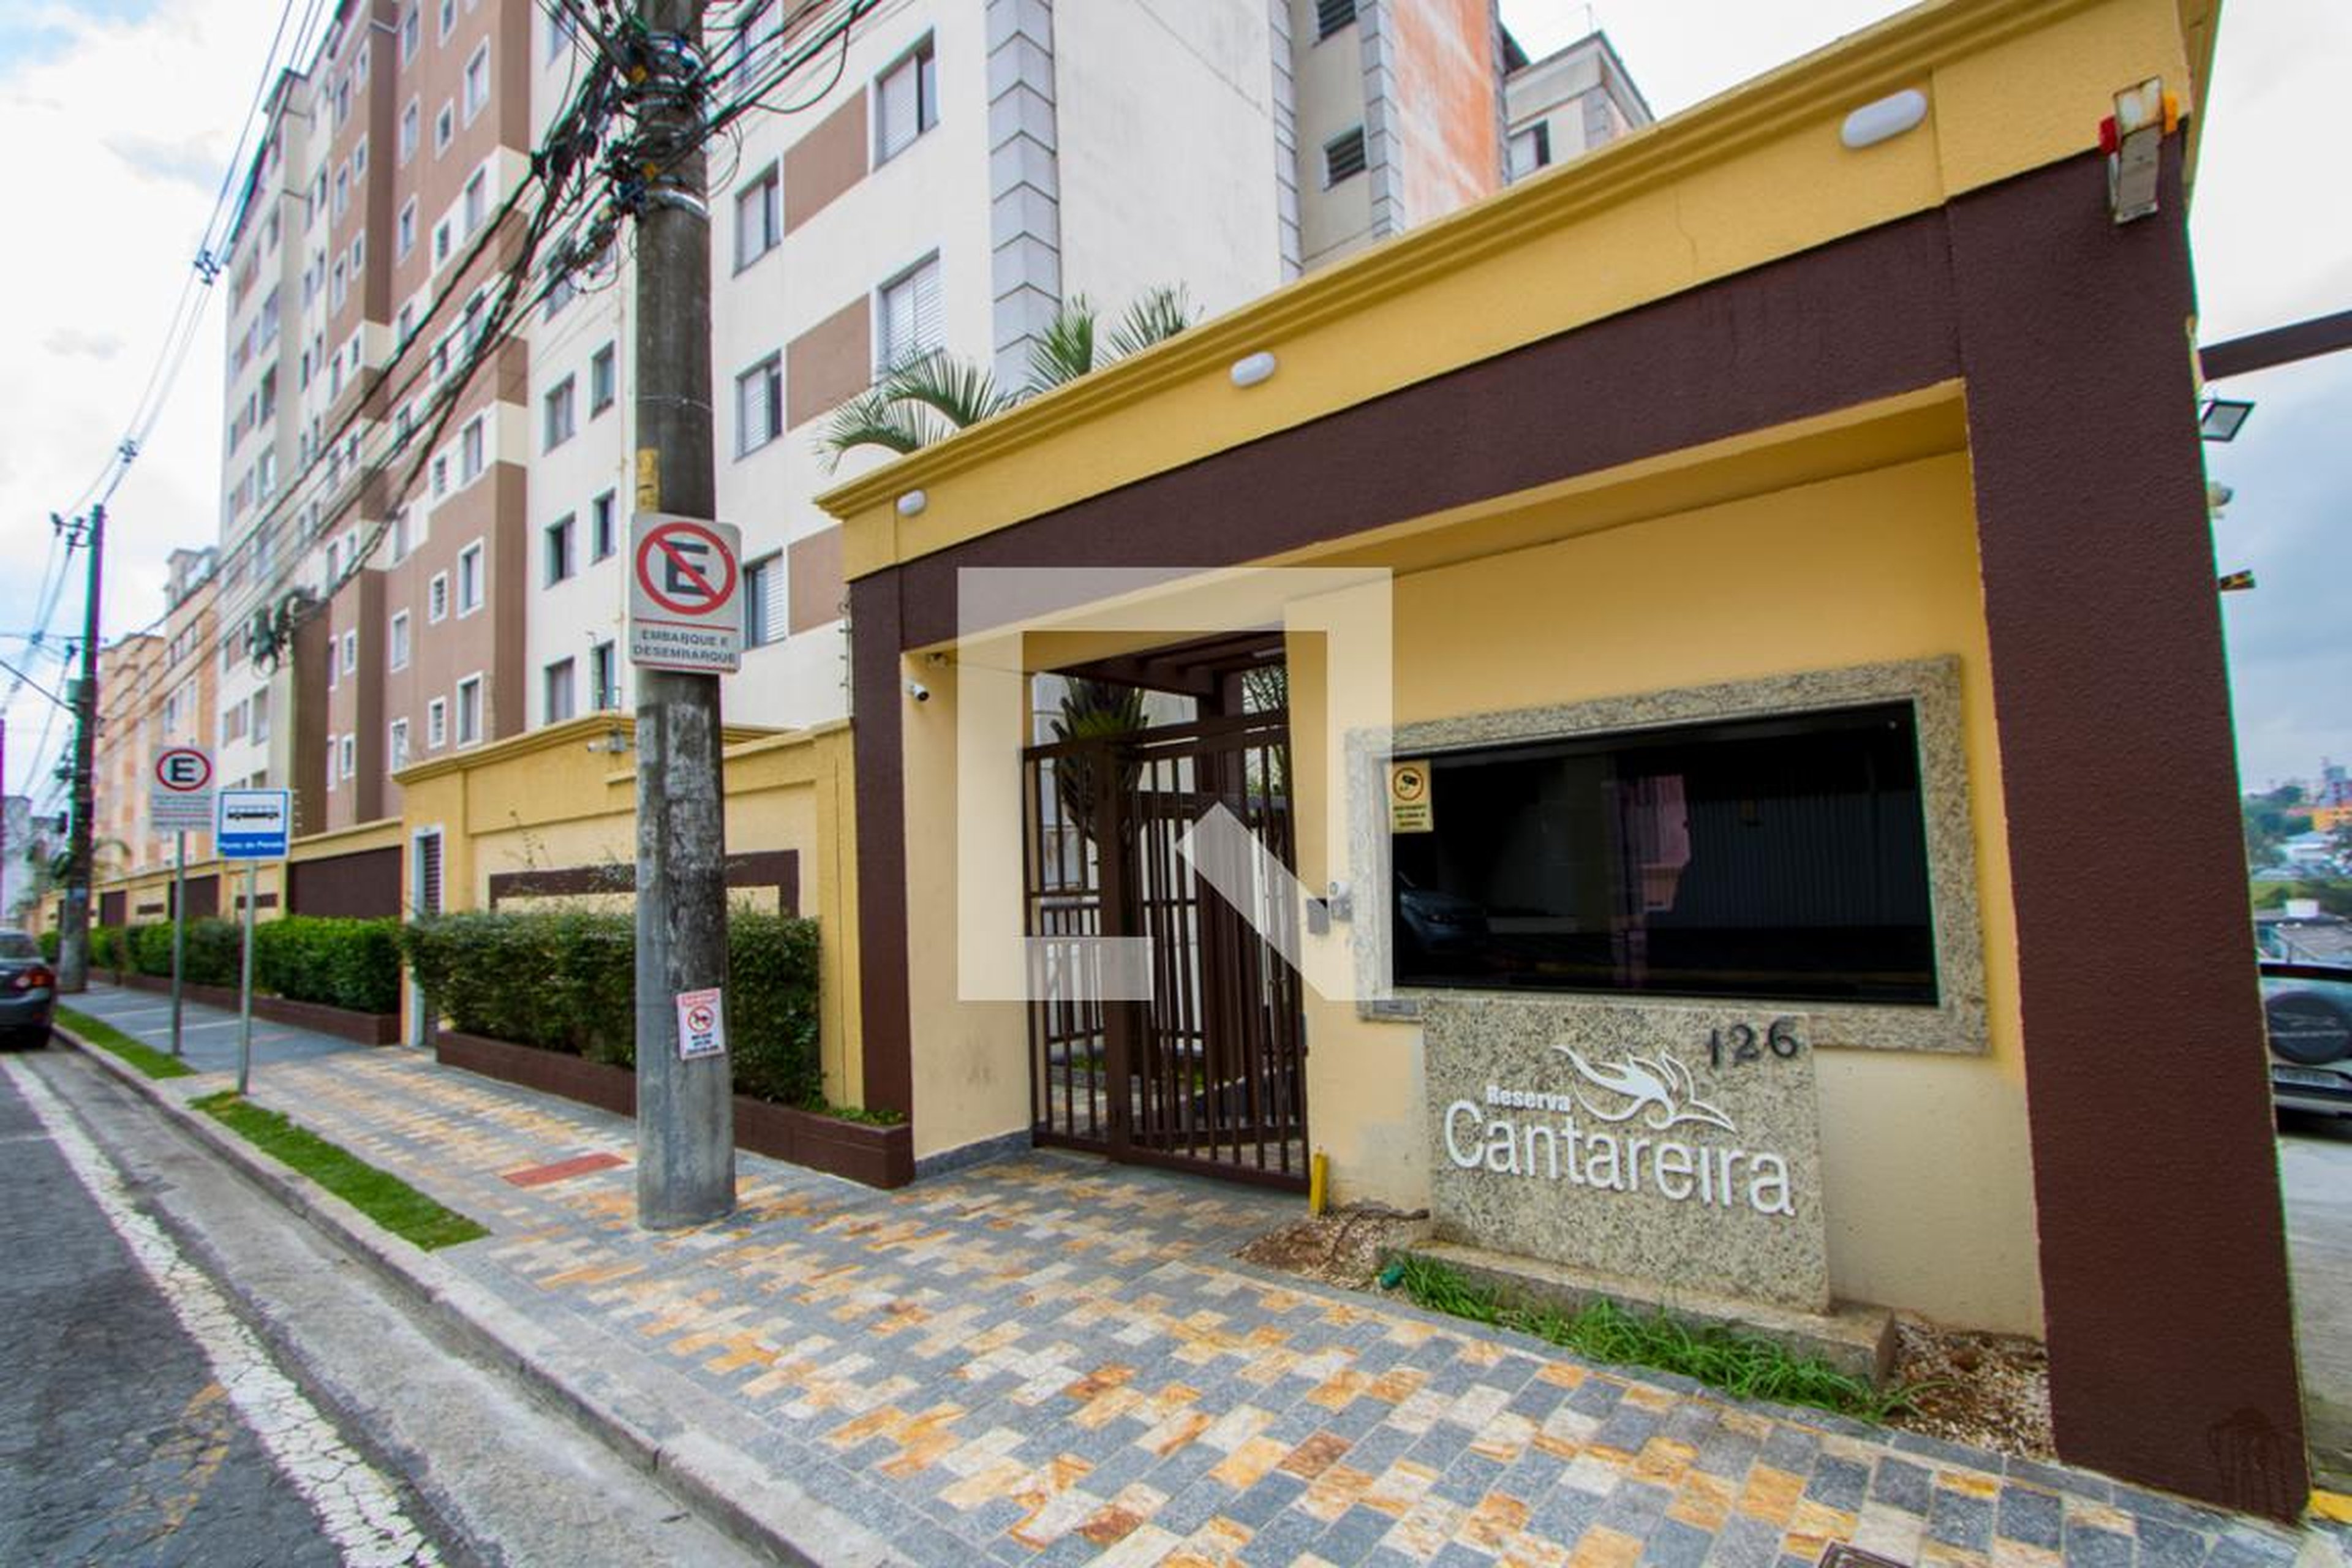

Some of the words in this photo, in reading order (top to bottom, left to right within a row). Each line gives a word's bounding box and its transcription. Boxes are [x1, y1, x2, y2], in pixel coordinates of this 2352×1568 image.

[666, 540, 709, 597] E
[642, 630, 717, 646] EMBARQUE
[634, 645, 734, 663] DESEMBARQUE
[171, 758, 196, 782] E
[1708, 1014, 1797, 1066] 126
[1486, 1085, 1571, 1112] Reserva
[1444, 1100, 1796, 1218] Cantareira
